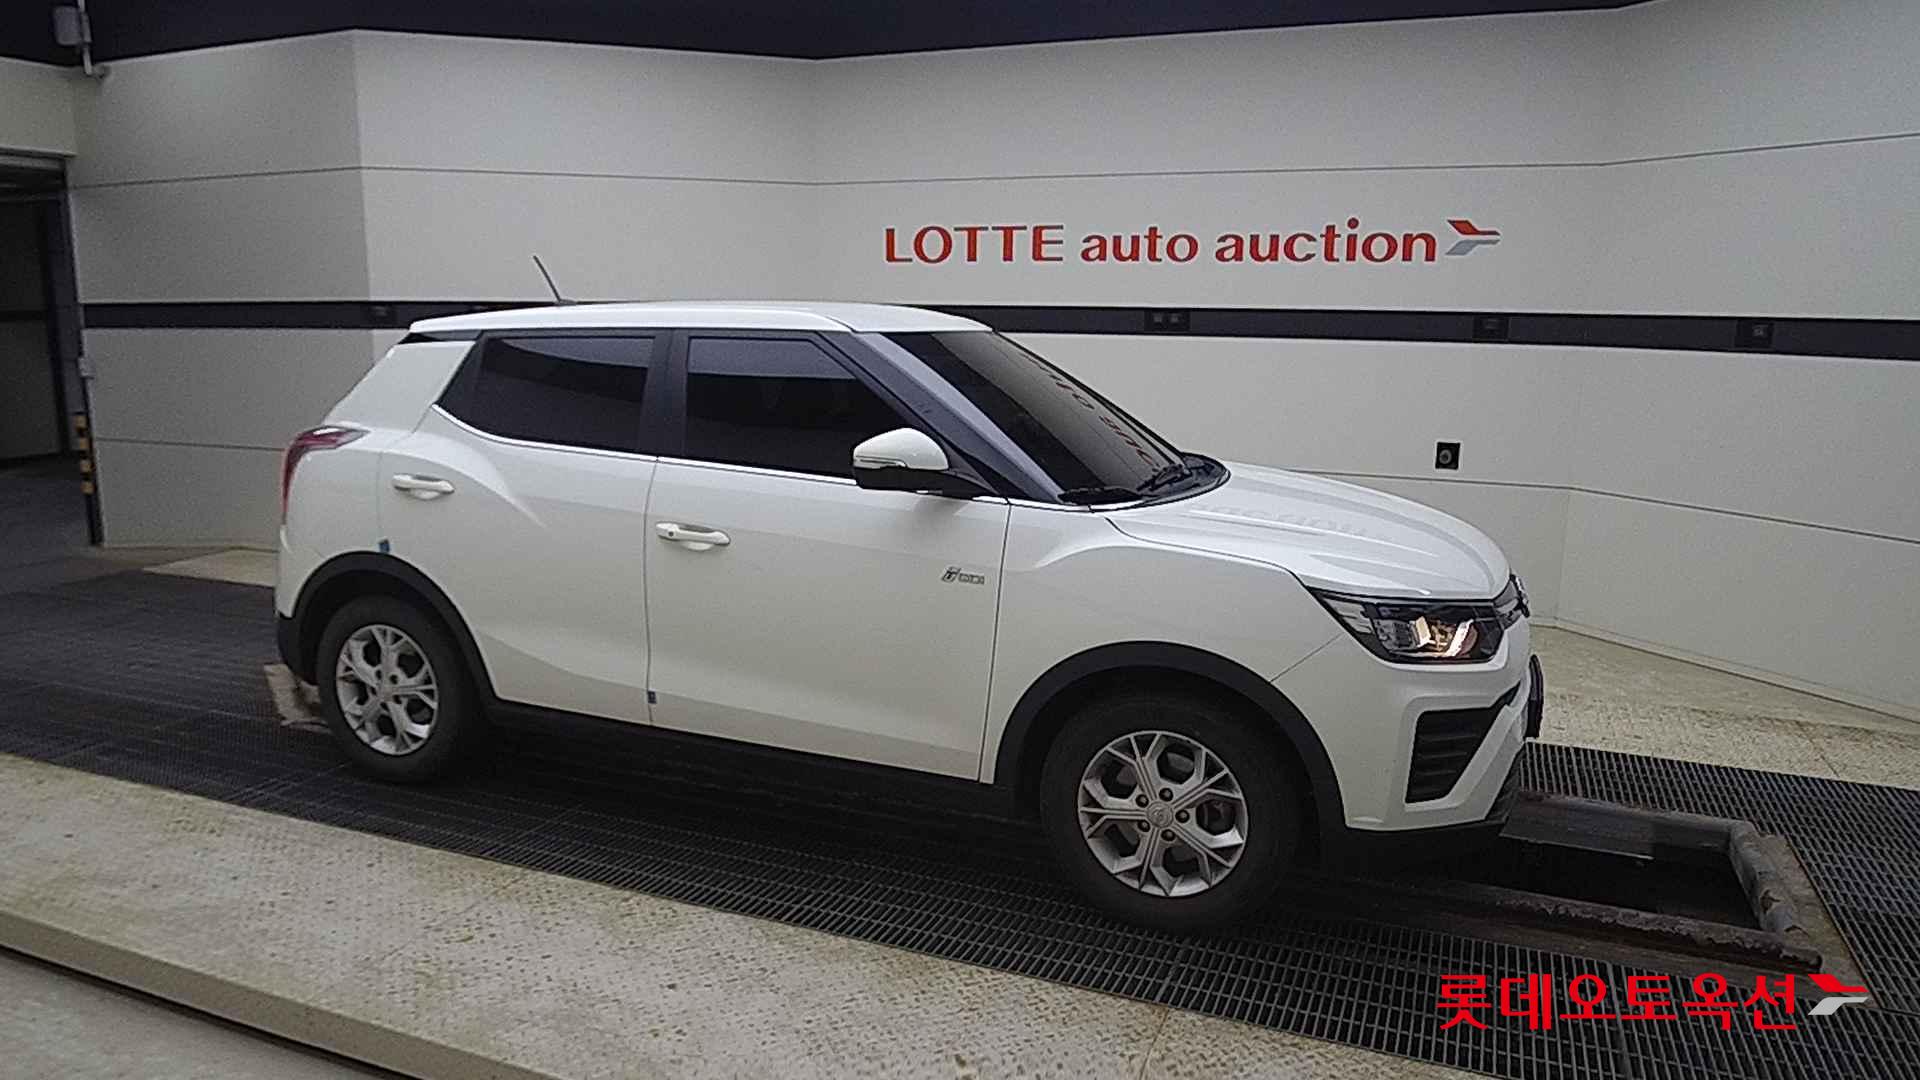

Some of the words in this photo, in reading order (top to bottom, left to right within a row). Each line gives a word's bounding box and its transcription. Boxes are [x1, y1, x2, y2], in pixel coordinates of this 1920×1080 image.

[884, 224, 1065, 264] LOTTE
[1080, 226, 1200, 264] auto
[1214, 217, 1438, 264] auction
